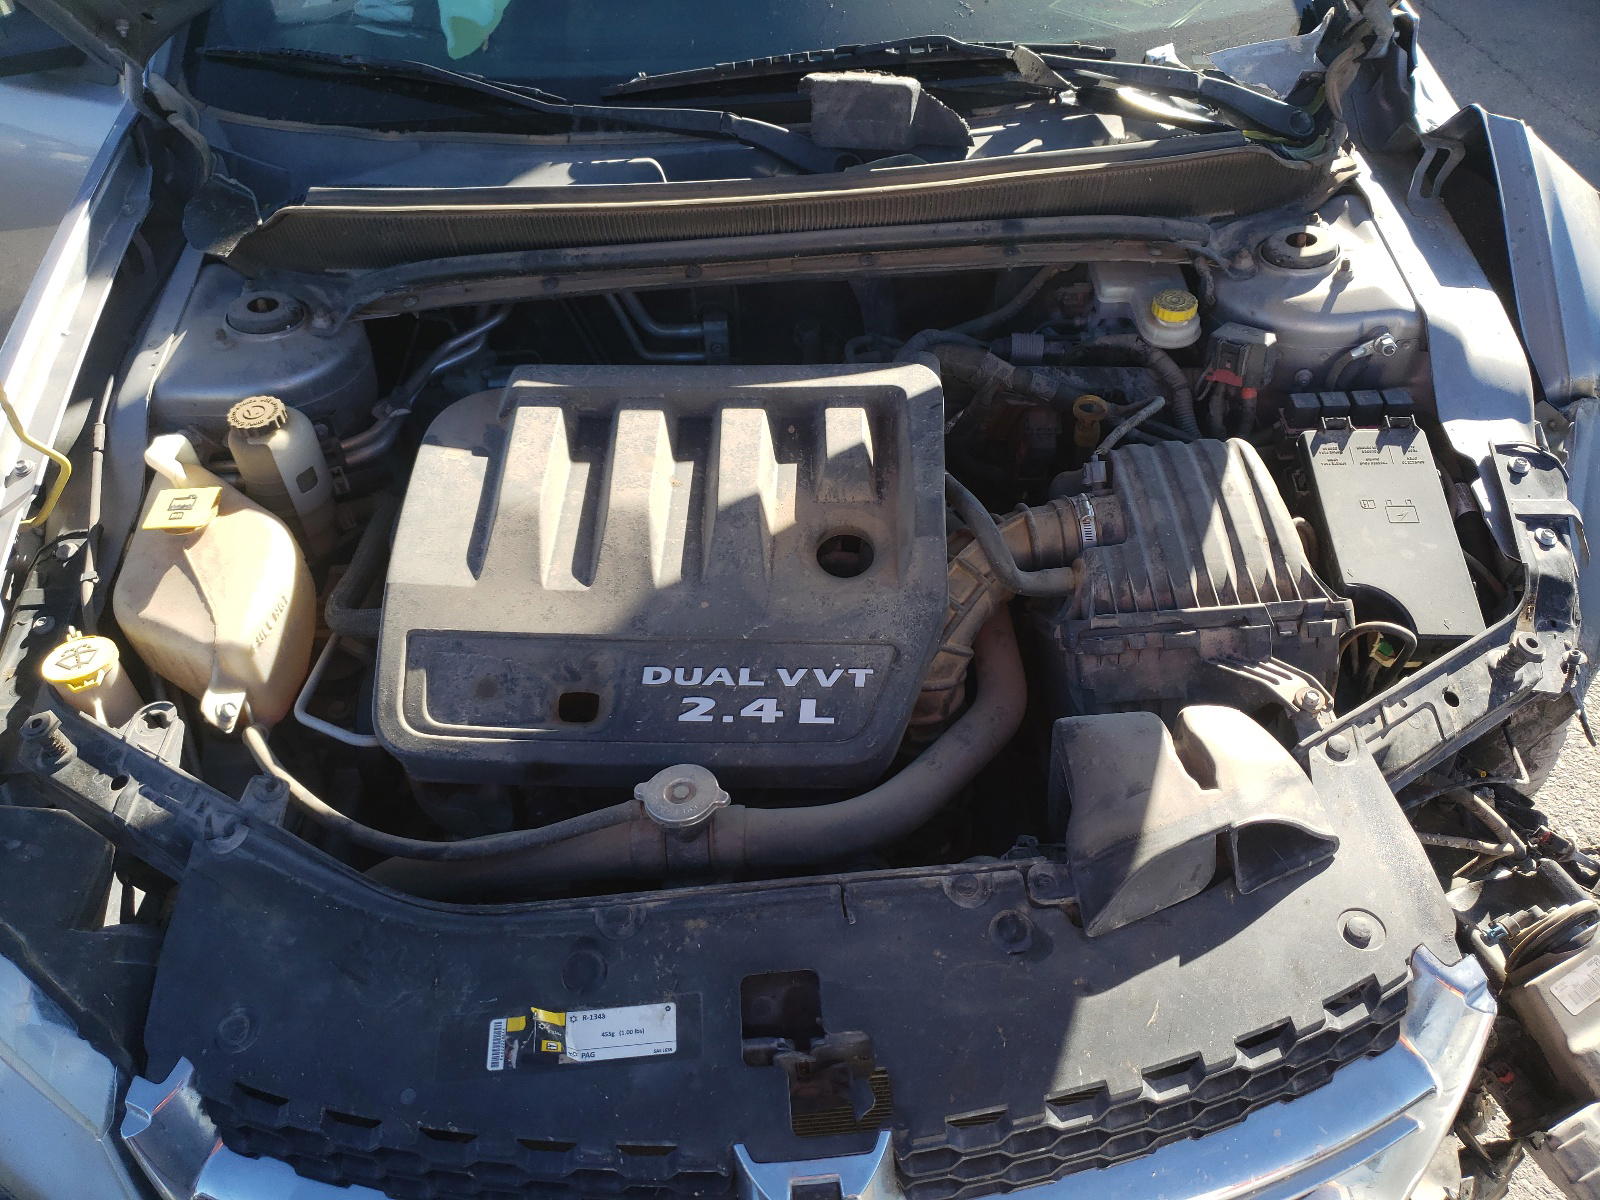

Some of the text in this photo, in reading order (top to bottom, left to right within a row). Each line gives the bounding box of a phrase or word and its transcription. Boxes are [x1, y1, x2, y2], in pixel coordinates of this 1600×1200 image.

[641, 666, 874, 688] DUAL VVT
[677, 696, 835, 724] 2.4L
[581, 1051, 596, 1059] PAG
